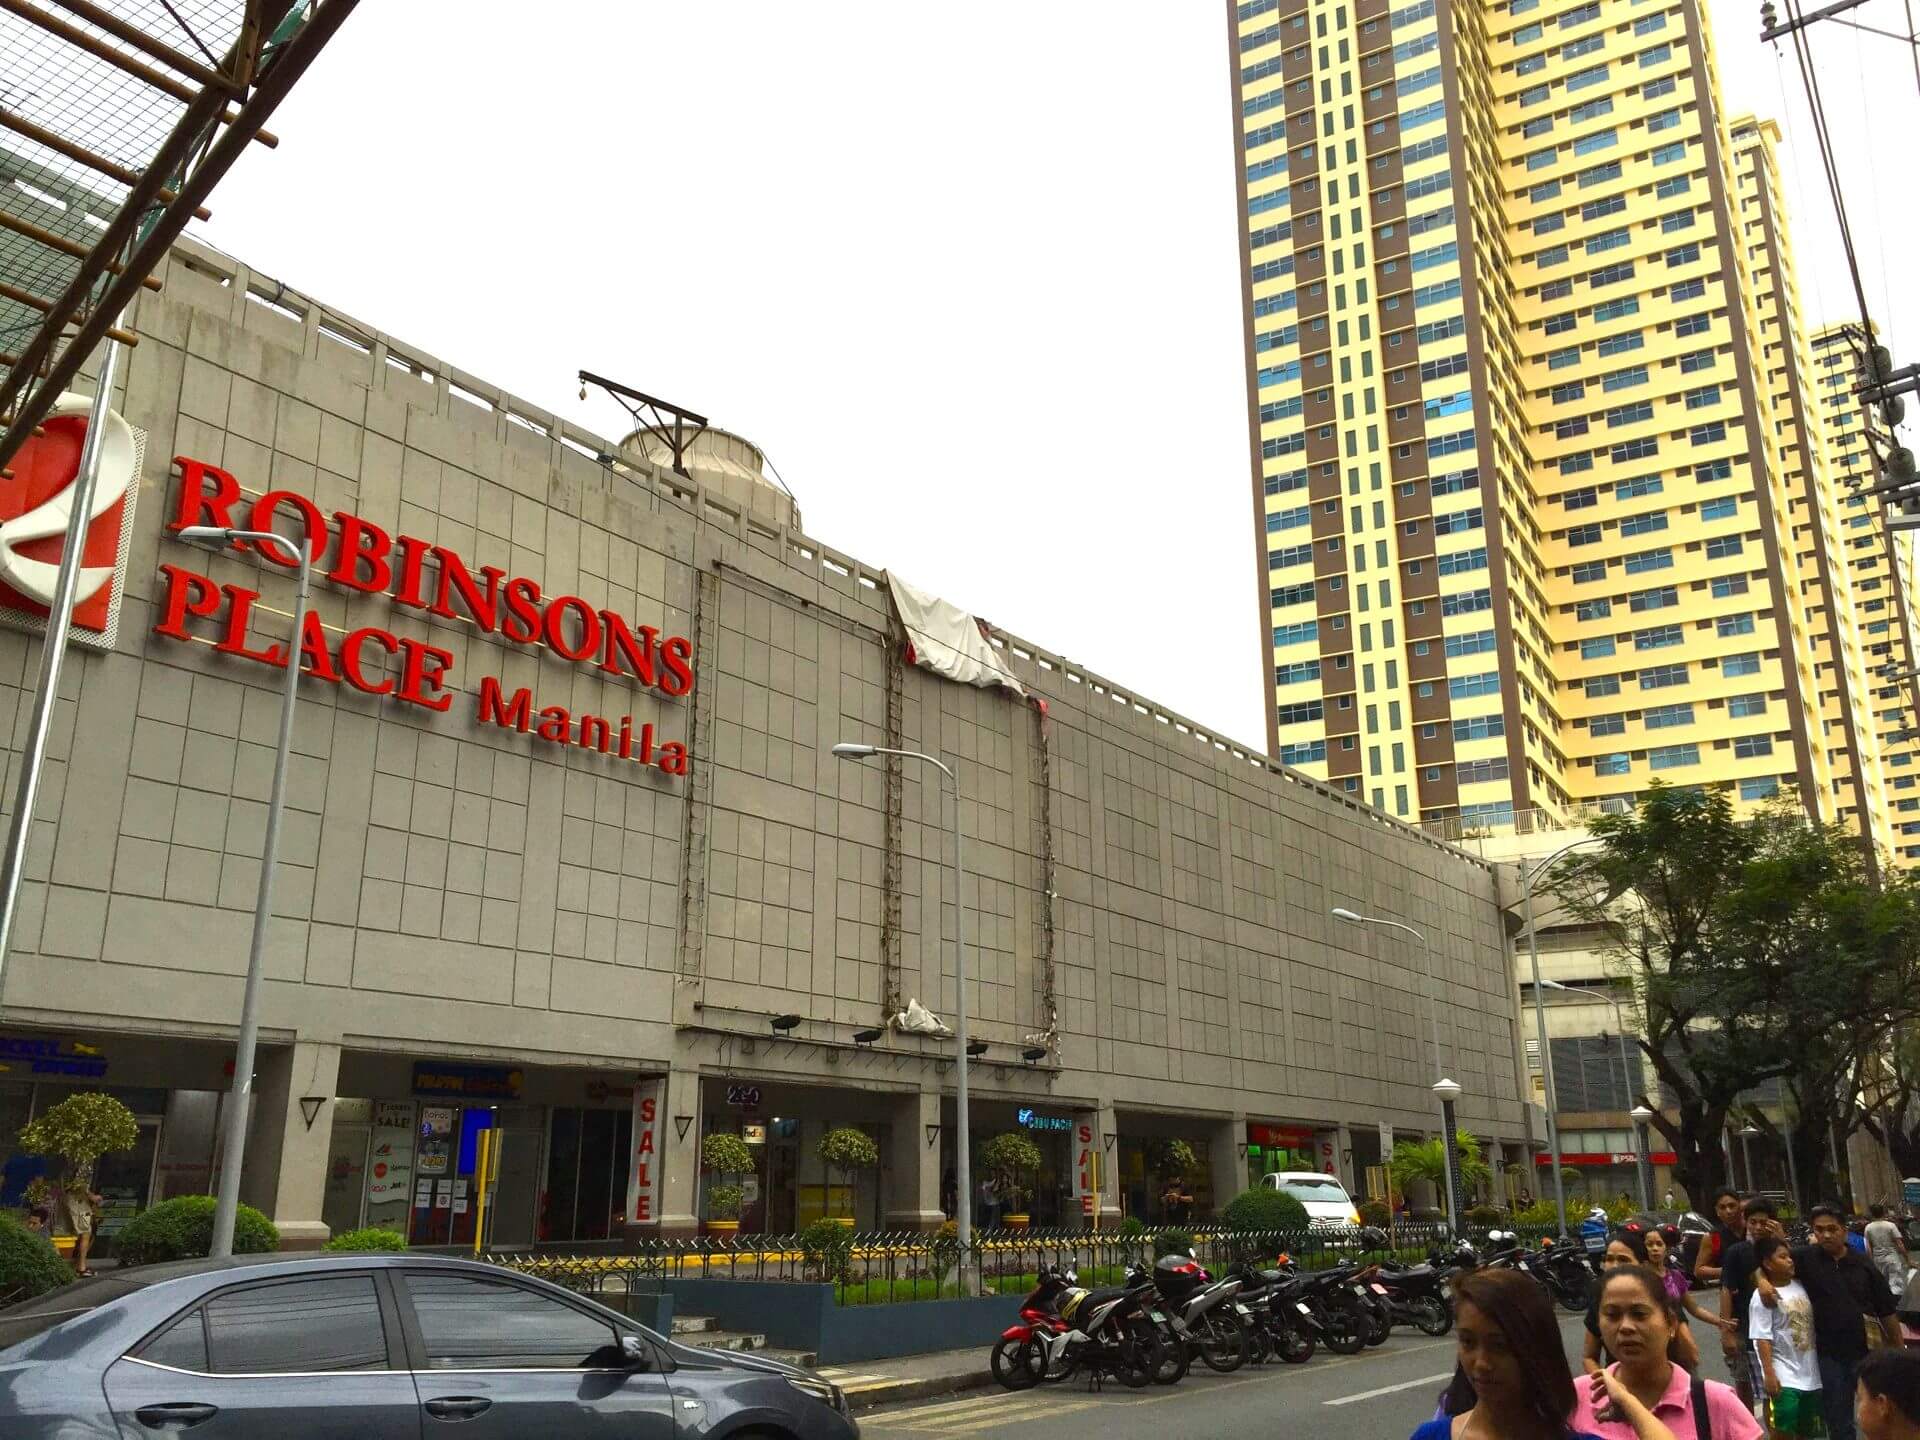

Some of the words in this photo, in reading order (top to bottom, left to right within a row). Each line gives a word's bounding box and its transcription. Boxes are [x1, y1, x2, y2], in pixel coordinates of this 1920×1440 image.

[166, 455, 694, 698] ROBINSONS
[153, 563, 454, 712] PLACE
[477, 675, 689, 777] Manila
[636, 1097, 656, 1220] SALE
[1321, 1142, 1335, 1174] SA
